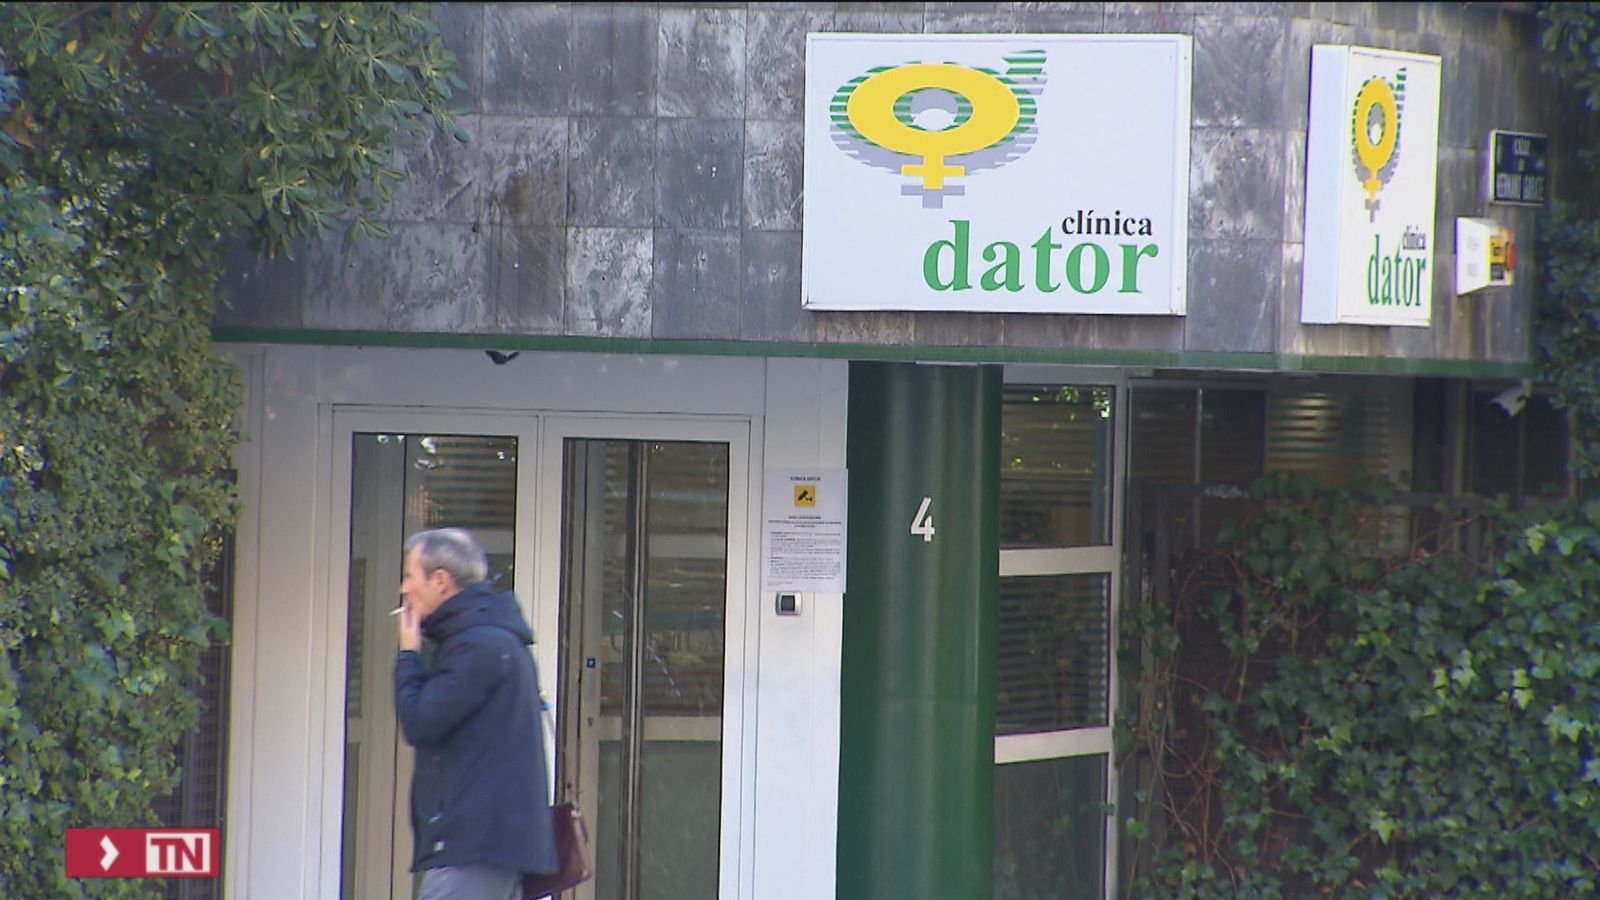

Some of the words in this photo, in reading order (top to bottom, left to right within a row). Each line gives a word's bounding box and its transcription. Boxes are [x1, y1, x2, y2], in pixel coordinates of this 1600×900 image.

[1061, 209, 1153, 236] clínica
[922, 219, 1159, 294] dator
[1367, 234, 1426, 307] dator
[910, 497, 936, 542] 4
